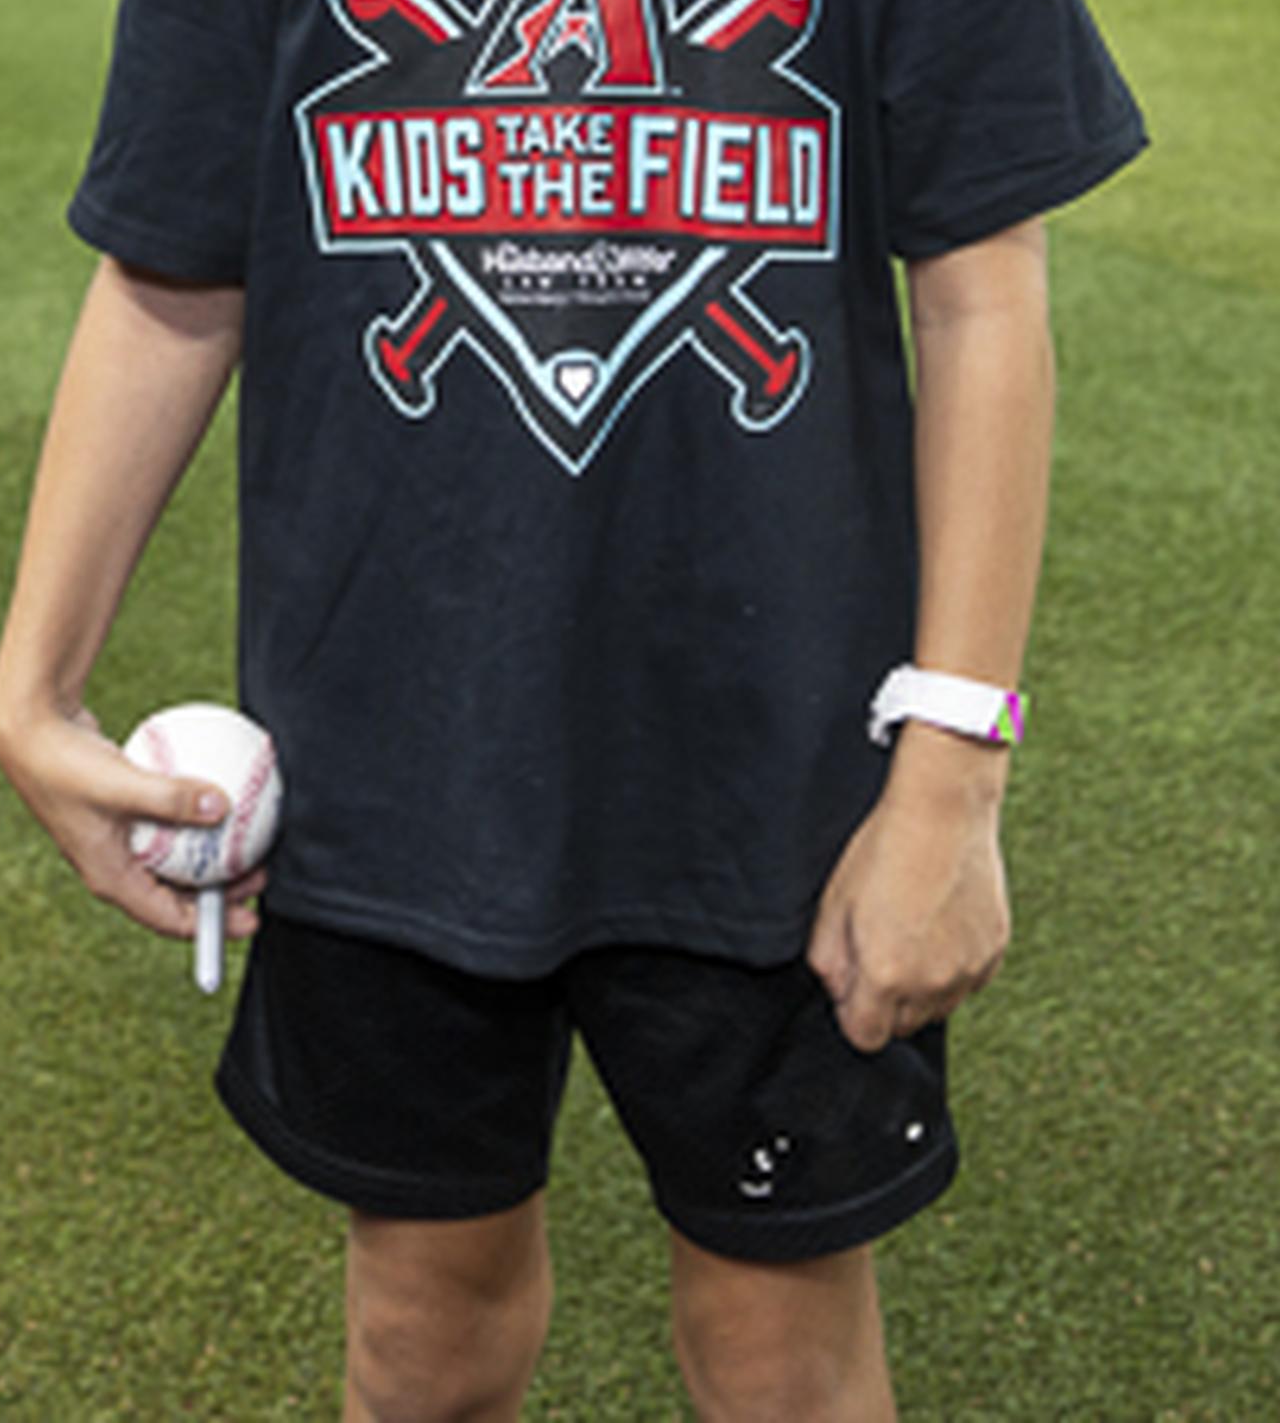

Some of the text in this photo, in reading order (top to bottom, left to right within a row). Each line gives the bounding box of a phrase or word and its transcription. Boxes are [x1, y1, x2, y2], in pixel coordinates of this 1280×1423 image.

[324, 113, 822, 224] KIDS TAKE FIELD
[498, 162, 614, 218] THE
